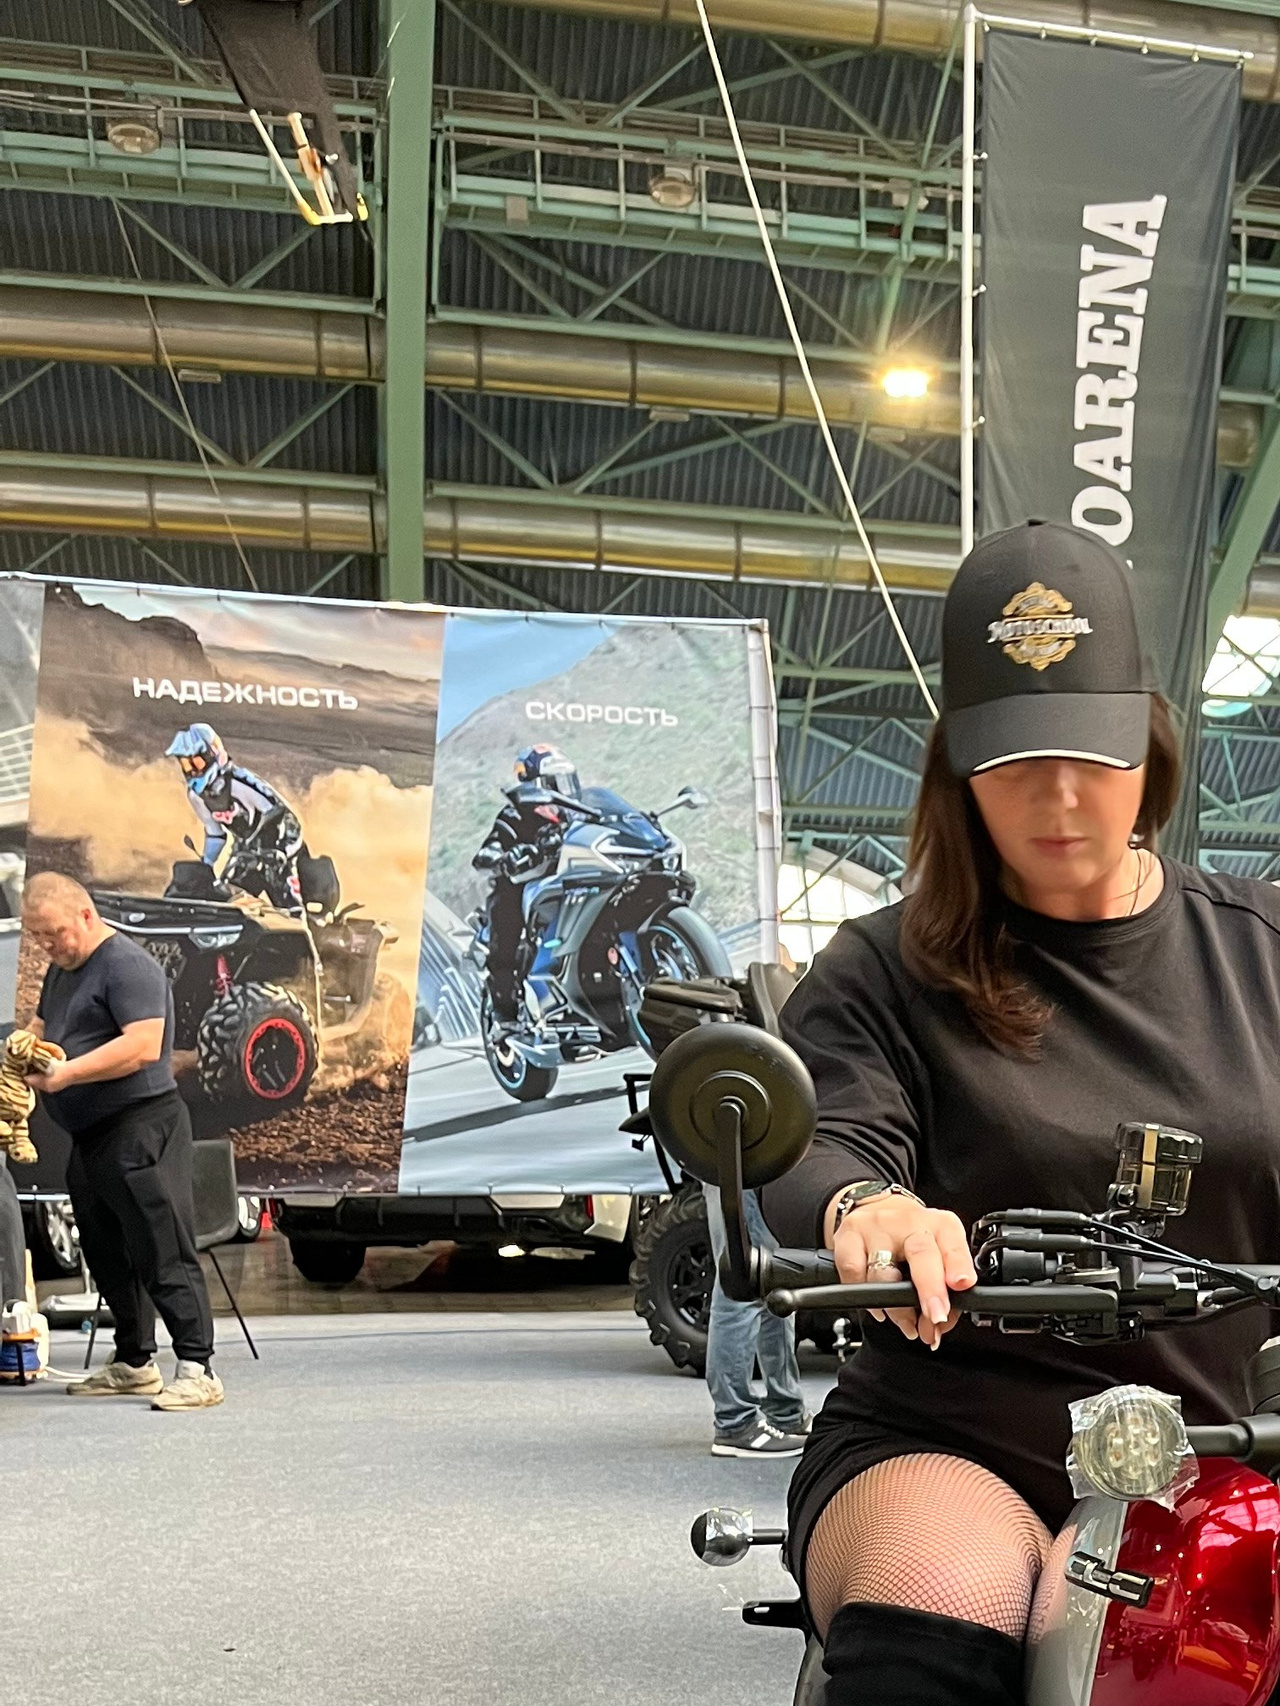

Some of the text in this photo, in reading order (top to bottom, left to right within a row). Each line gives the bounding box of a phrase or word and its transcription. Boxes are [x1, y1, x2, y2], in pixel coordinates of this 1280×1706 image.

[1070, 193, 1168, 569] OARENA
[131, 676, 359, 710] НАДЕЖНОСТЬ
[525, 701, 679, 727] СКОРОСТЬ
